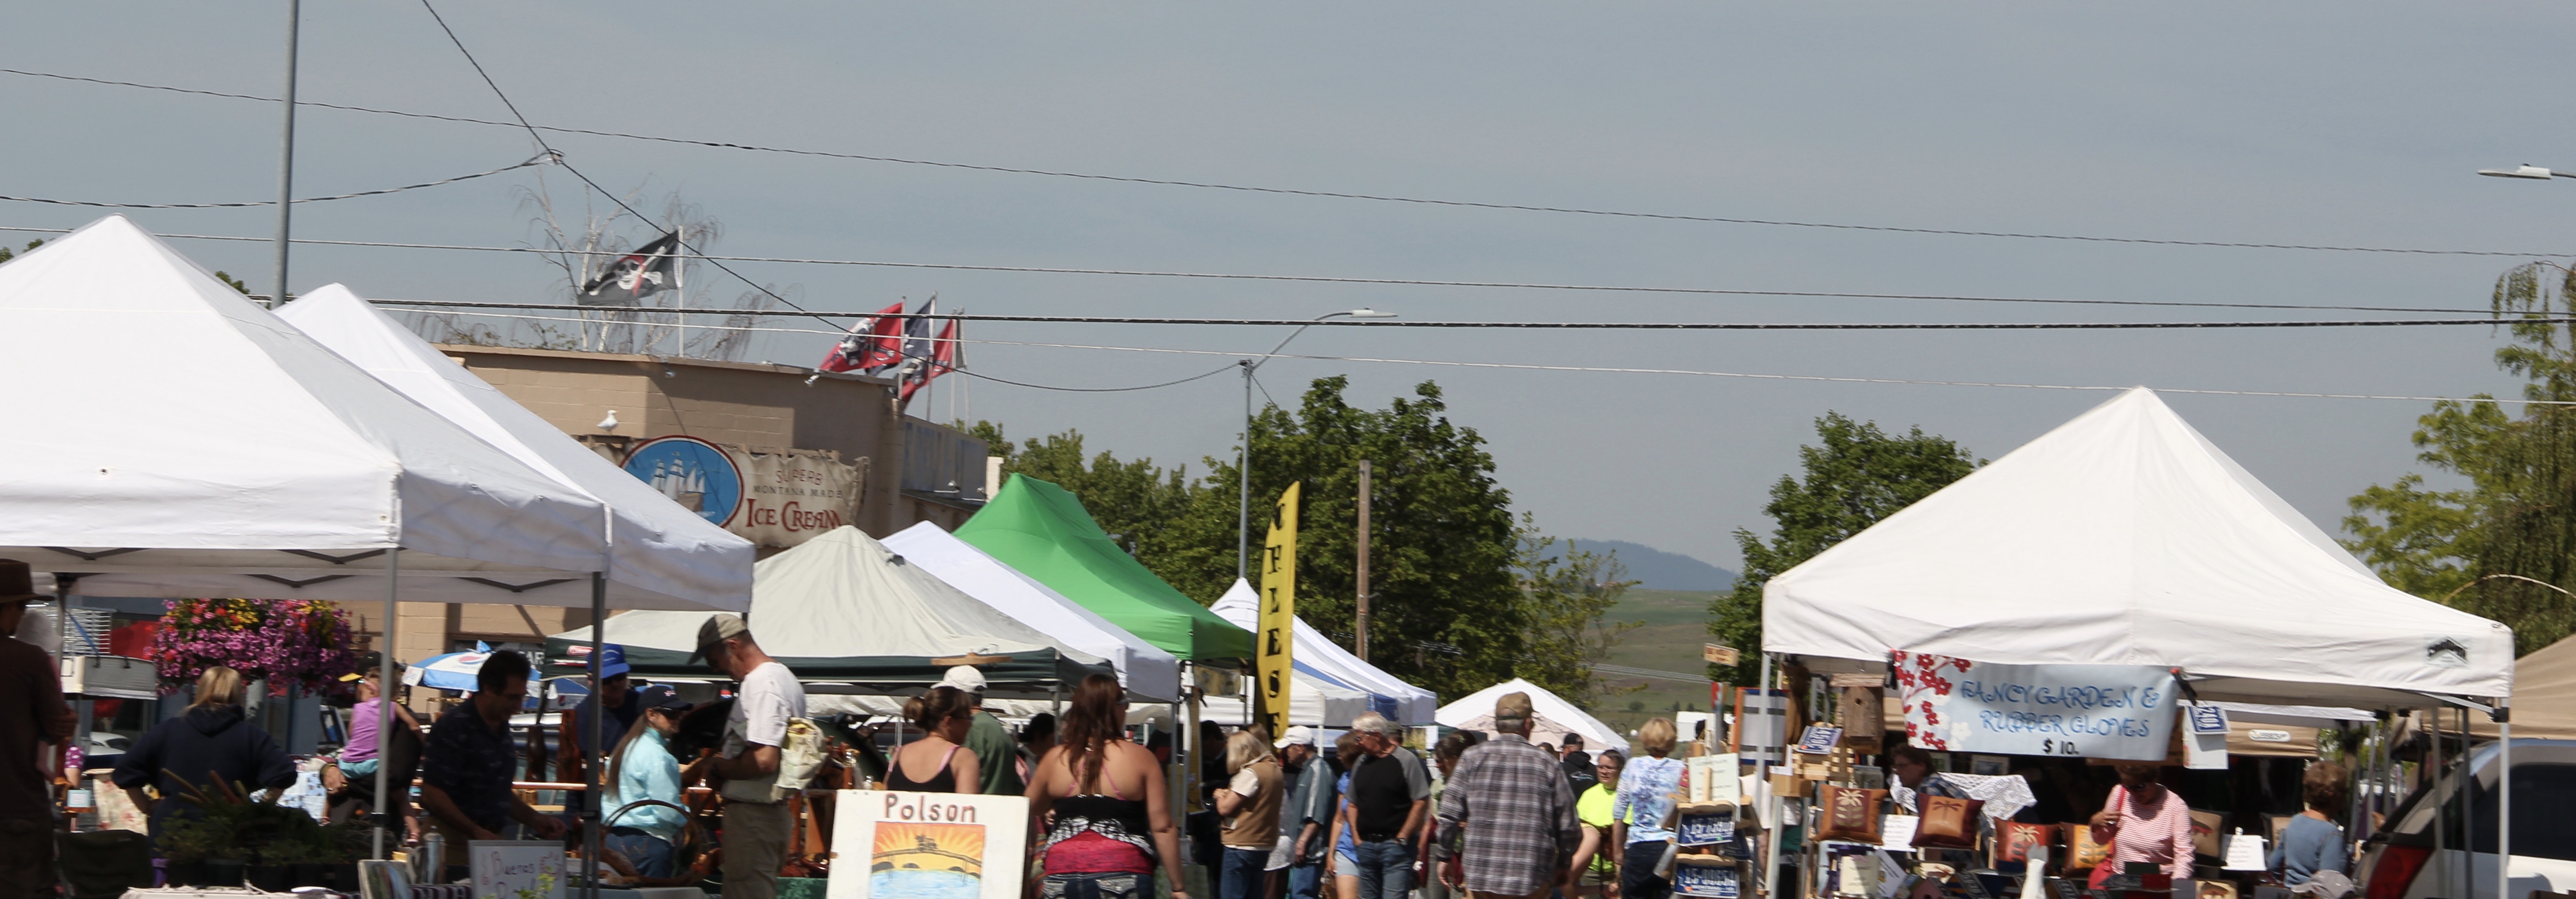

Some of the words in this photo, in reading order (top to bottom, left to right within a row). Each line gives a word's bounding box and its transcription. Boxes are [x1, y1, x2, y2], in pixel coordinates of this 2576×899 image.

[754, 485, 805, 496] MONTANA
[810, 488, 843, 498] MADE
[775, 469, 823, 486] SUPERB
[1959, 680, 2033, 703] FANCY
[2035, 685, 2138, 710] GARDEN
[2141, 686, 2161, 709] &
[1979, 709, 2071, 737] RUBBER
[2069, 715, 2151, 738] GLOVES
[885, 792, 976, 823] Polson
